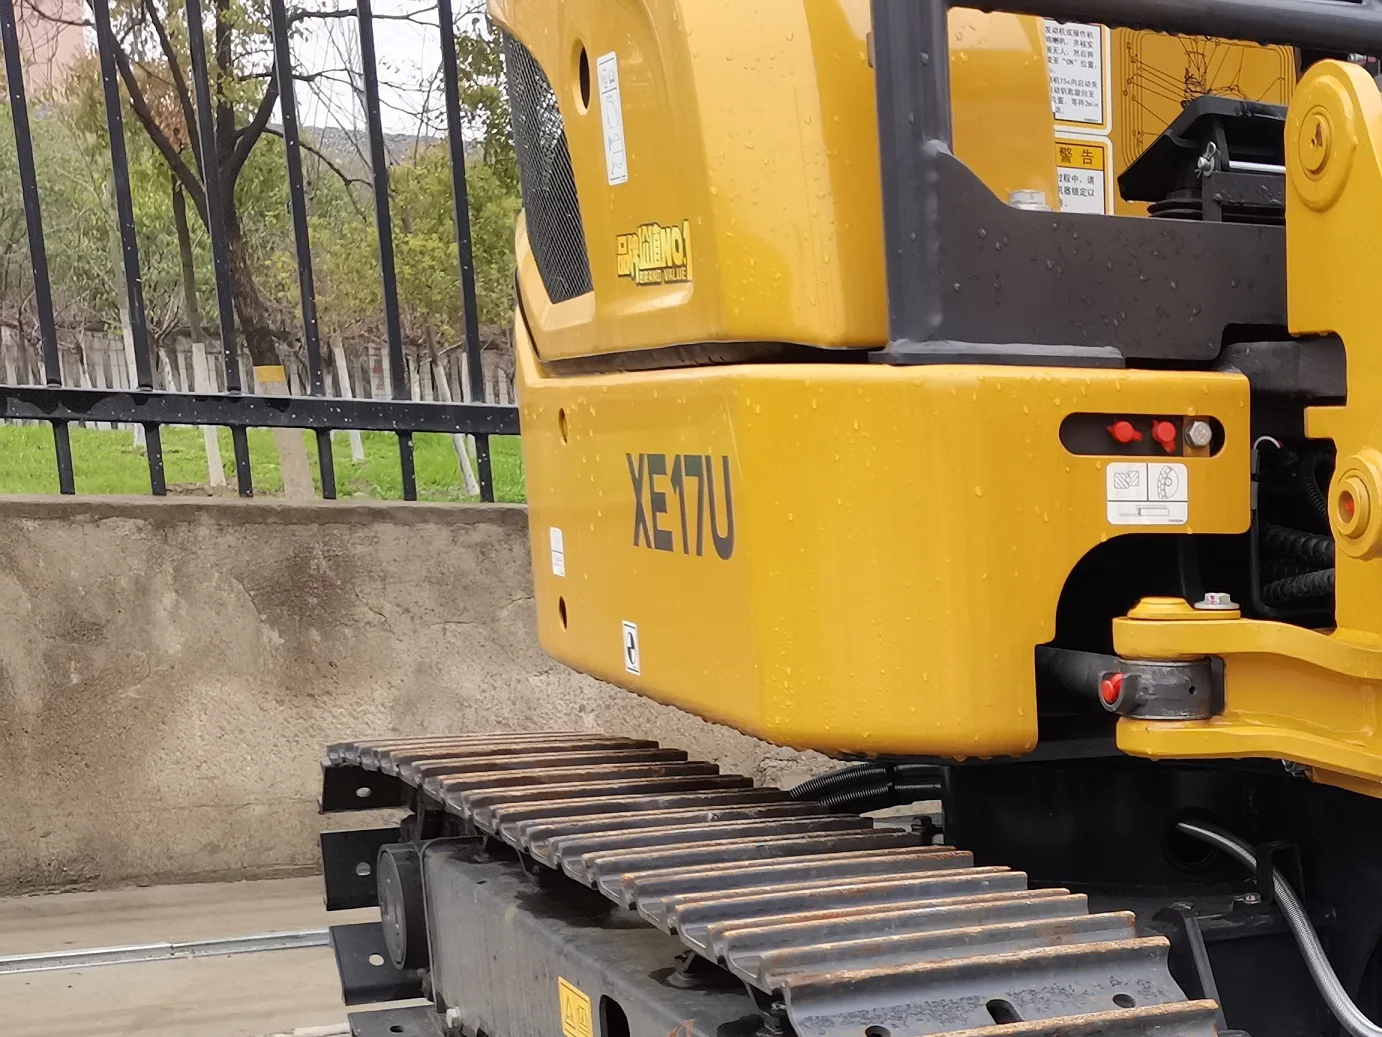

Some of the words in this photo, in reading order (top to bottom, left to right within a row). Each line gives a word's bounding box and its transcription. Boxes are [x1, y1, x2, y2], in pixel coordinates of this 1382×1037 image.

[1059, 147, 1094, 165] 警告
[663, 267, 687, 283] VALUE
[625, 453, 735, 561] XE17U
